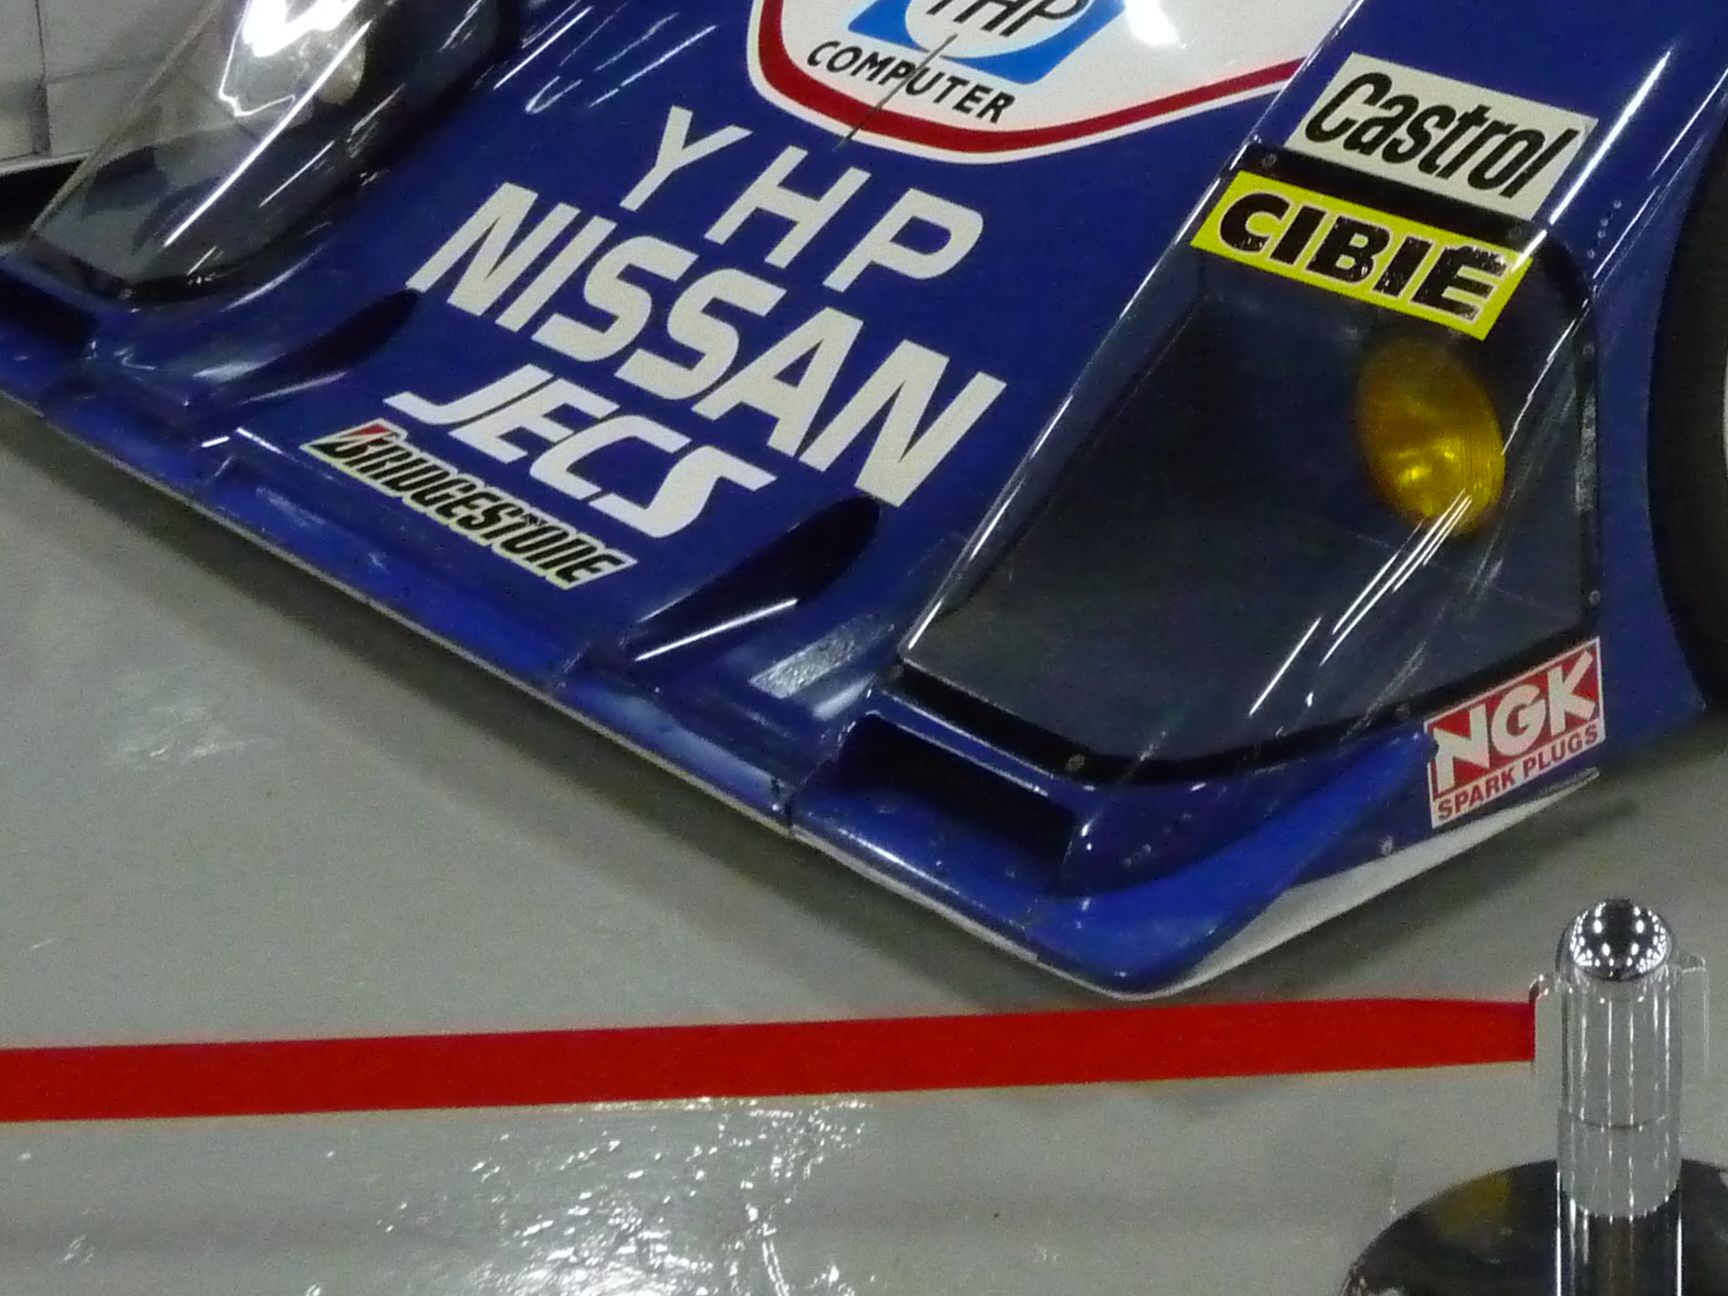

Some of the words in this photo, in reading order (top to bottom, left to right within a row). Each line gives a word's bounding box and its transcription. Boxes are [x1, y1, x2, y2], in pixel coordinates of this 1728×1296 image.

[806, 40, 1015, 125] COMPUTER
[1302, 70, 1581, 200] Castrol
[618, 105, 984, 292] YHP
[1217, 190, 1517, 322] CIBIE
[404, 181, 1008, 507] NISSAN
[303, 420, 634, 586] BRIDGESTONE
[382, 363, 777, 539] JECS
[1432, 650, 1597, 795] NGK
[1437, 766, 1517, 821] SPARK
[1522, 724, 1598, 779] PLUGS
